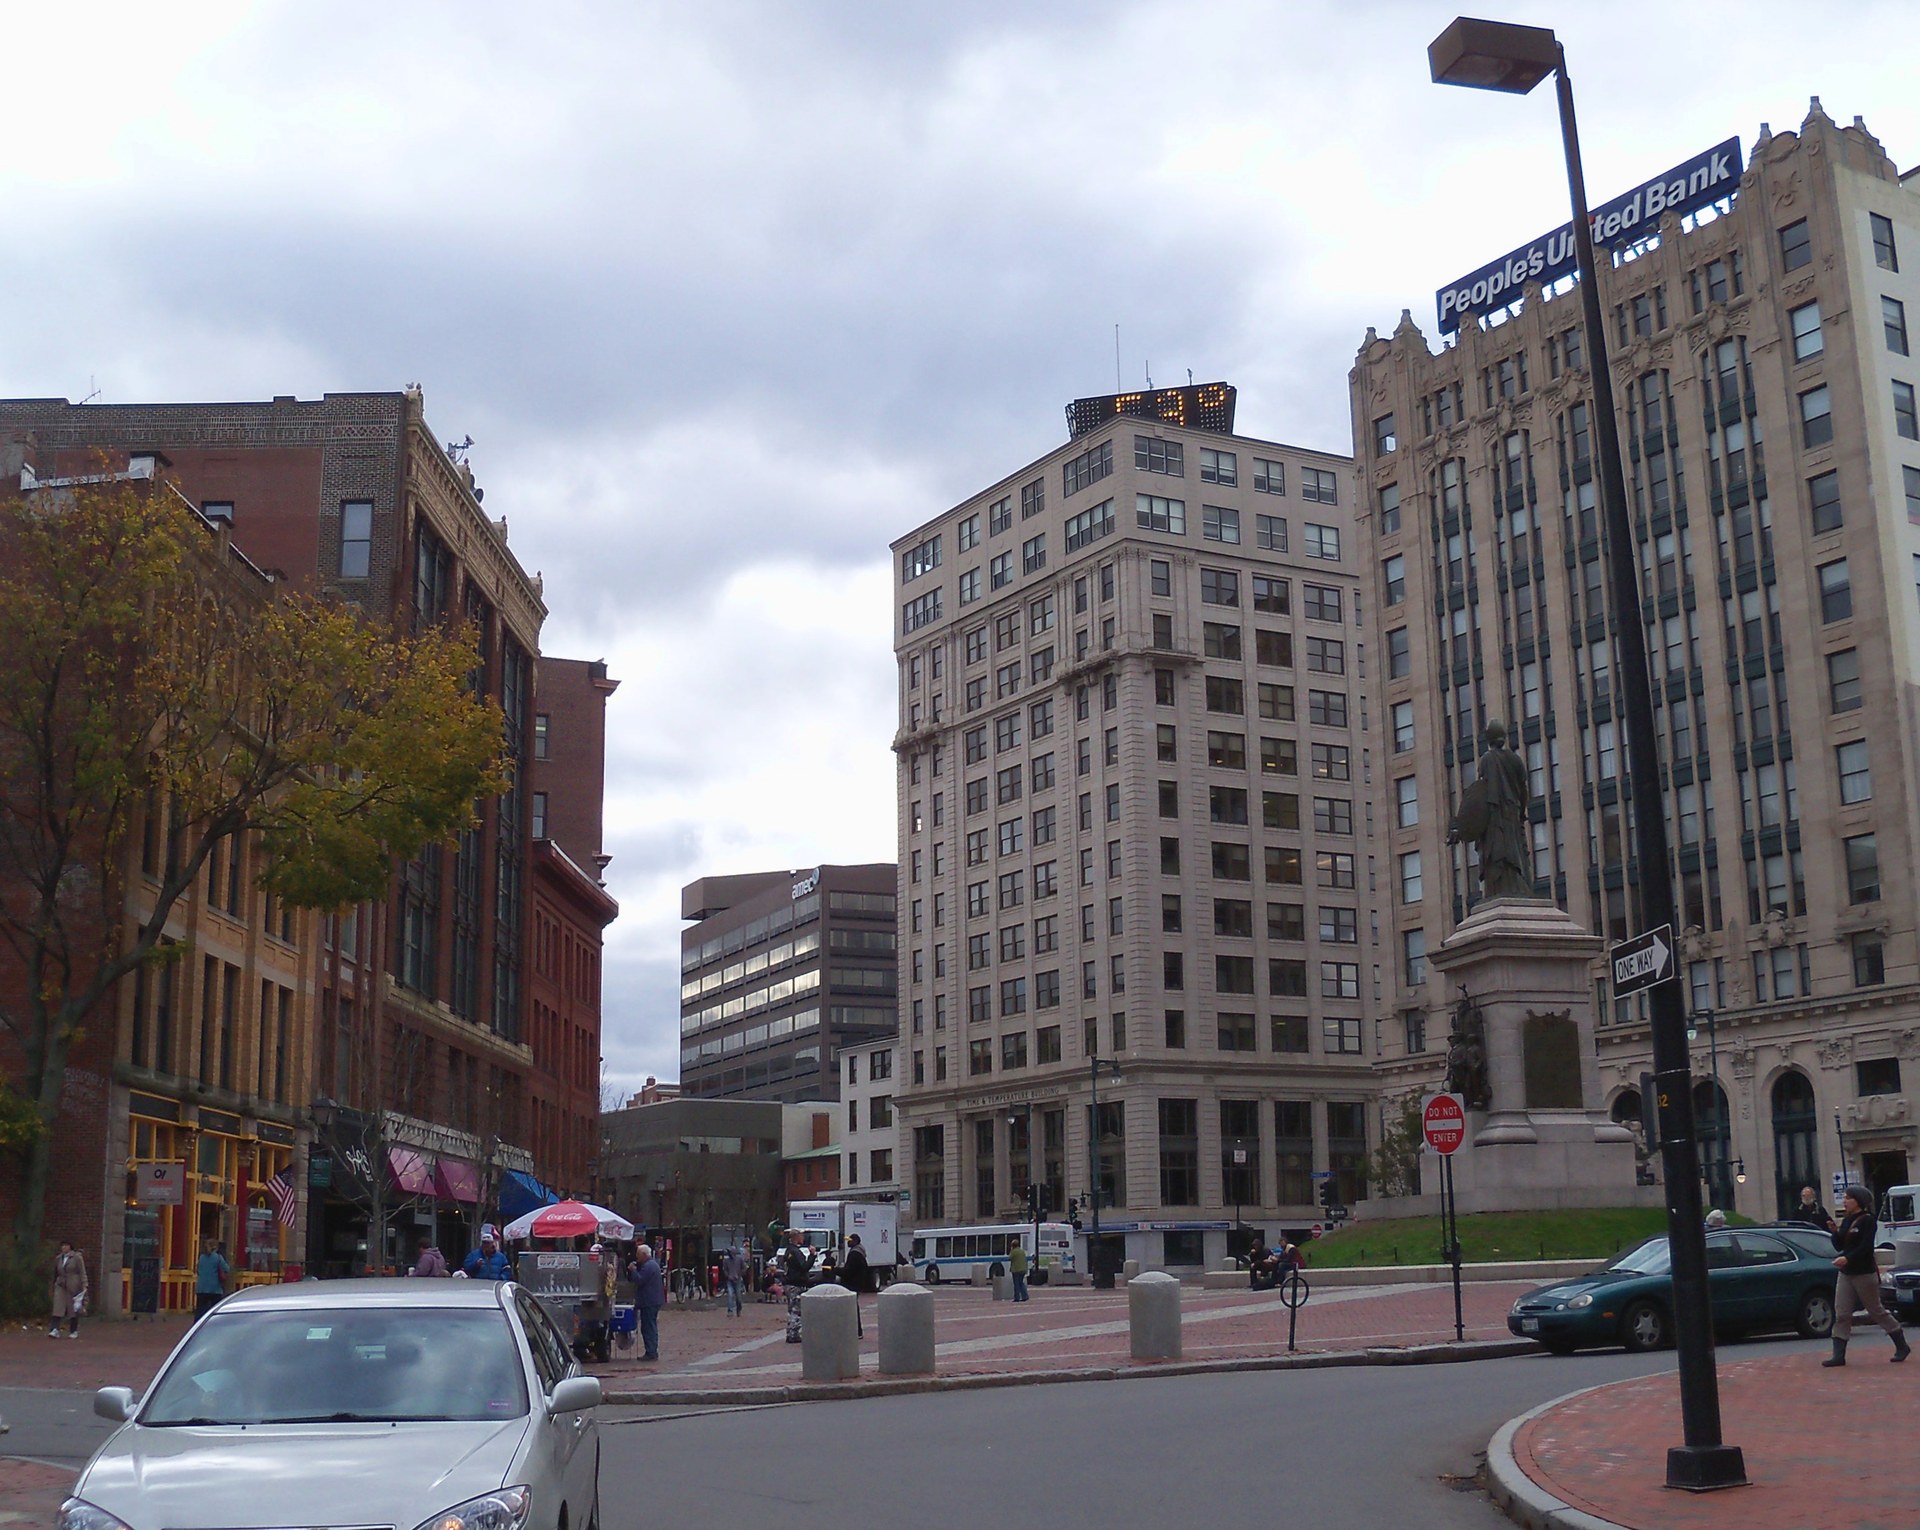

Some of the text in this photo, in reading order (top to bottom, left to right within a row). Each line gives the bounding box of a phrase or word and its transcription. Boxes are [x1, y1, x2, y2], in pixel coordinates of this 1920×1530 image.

[1439, 247, 1544, 322] People's
[1644, 152, 1731, 218] Bank
[791, 877, 814, 900] amec
[1617, 948, 1654, 980] ONE WAY
[1428, 1106, 1458, 1117] DO NOT
[1433, 1132, 1457, 1143] ENTER
